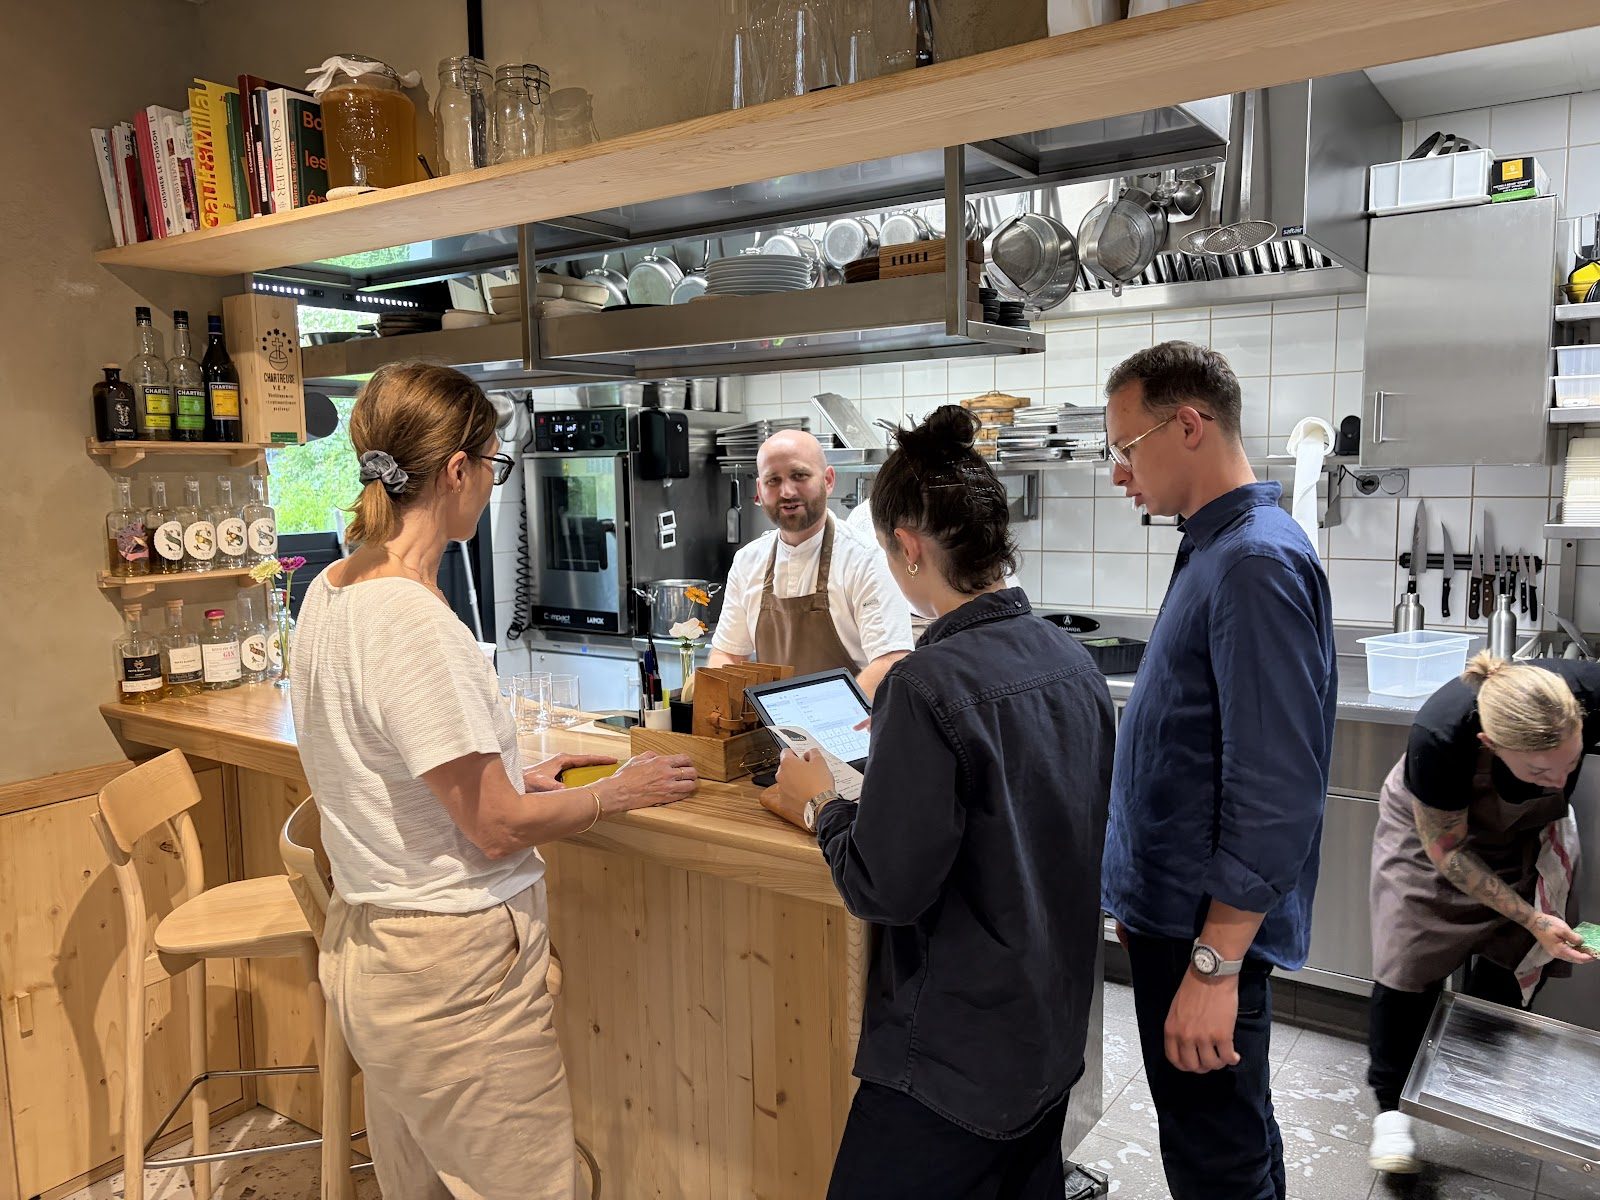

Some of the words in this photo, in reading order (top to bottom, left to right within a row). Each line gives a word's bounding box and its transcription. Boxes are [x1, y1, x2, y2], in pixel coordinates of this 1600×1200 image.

[151, 129, 161, 164] POISSON
[304, 149, 328, 171] les
[158, 175, 168, 209] CUISINER
[264, 372, 296, 384] CHARTREUSE
